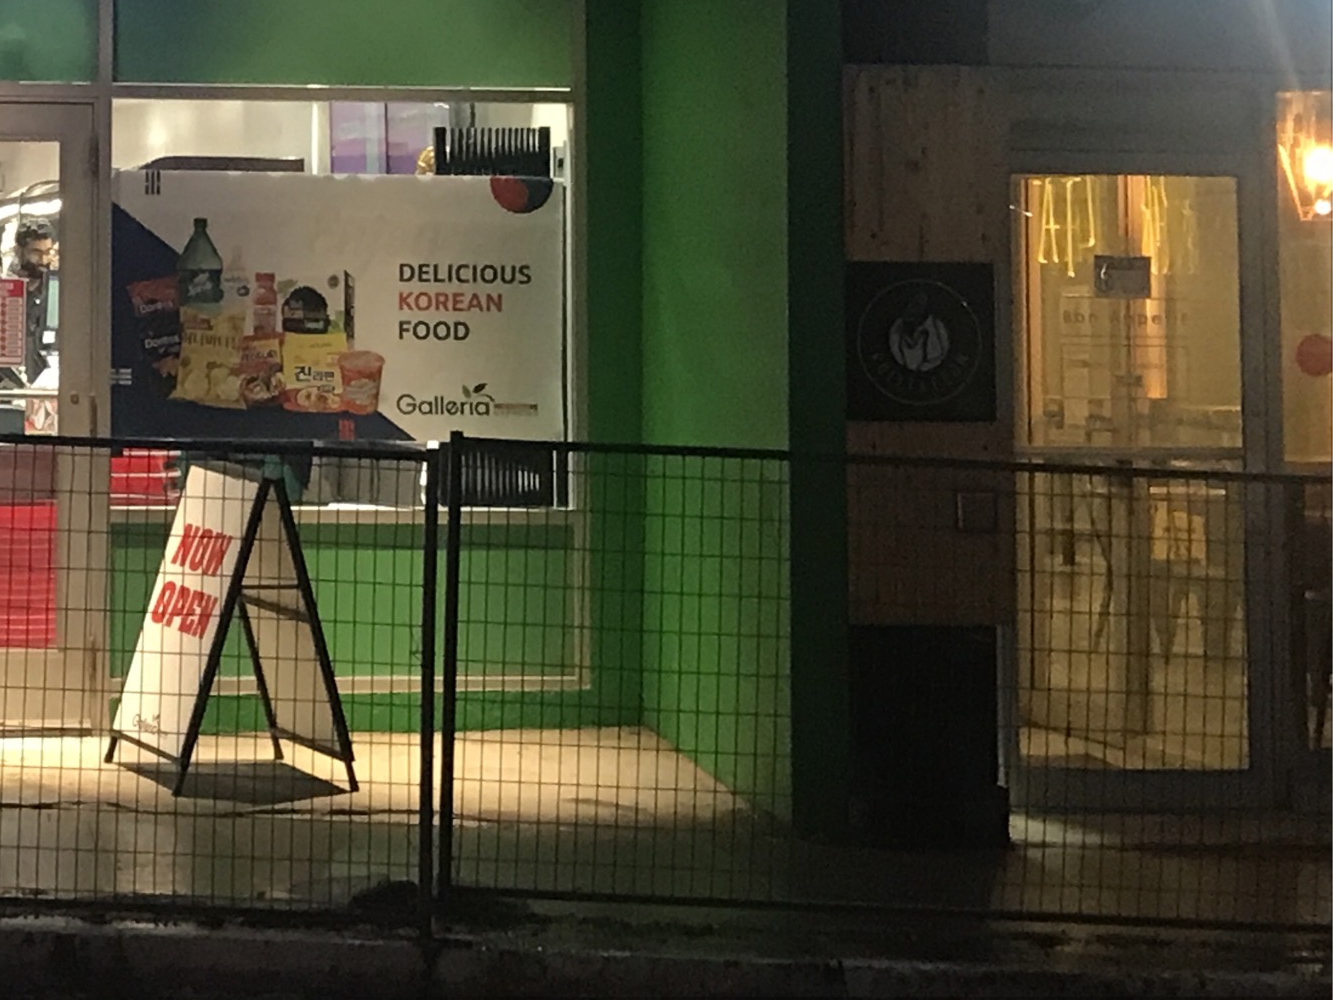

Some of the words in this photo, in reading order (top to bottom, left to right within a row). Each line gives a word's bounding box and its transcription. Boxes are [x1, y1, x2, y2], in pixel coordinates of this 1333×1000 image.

[398, 263, 533, 285] DELICIOUS
[398, 291, 503, 313] KOREAN
[398, 320, 471, 341] FOOD
[396, 393, 491, 416] Galleria
[171, 523, 233, 576] NOW
[151, 580, 218, 640] OPEN
